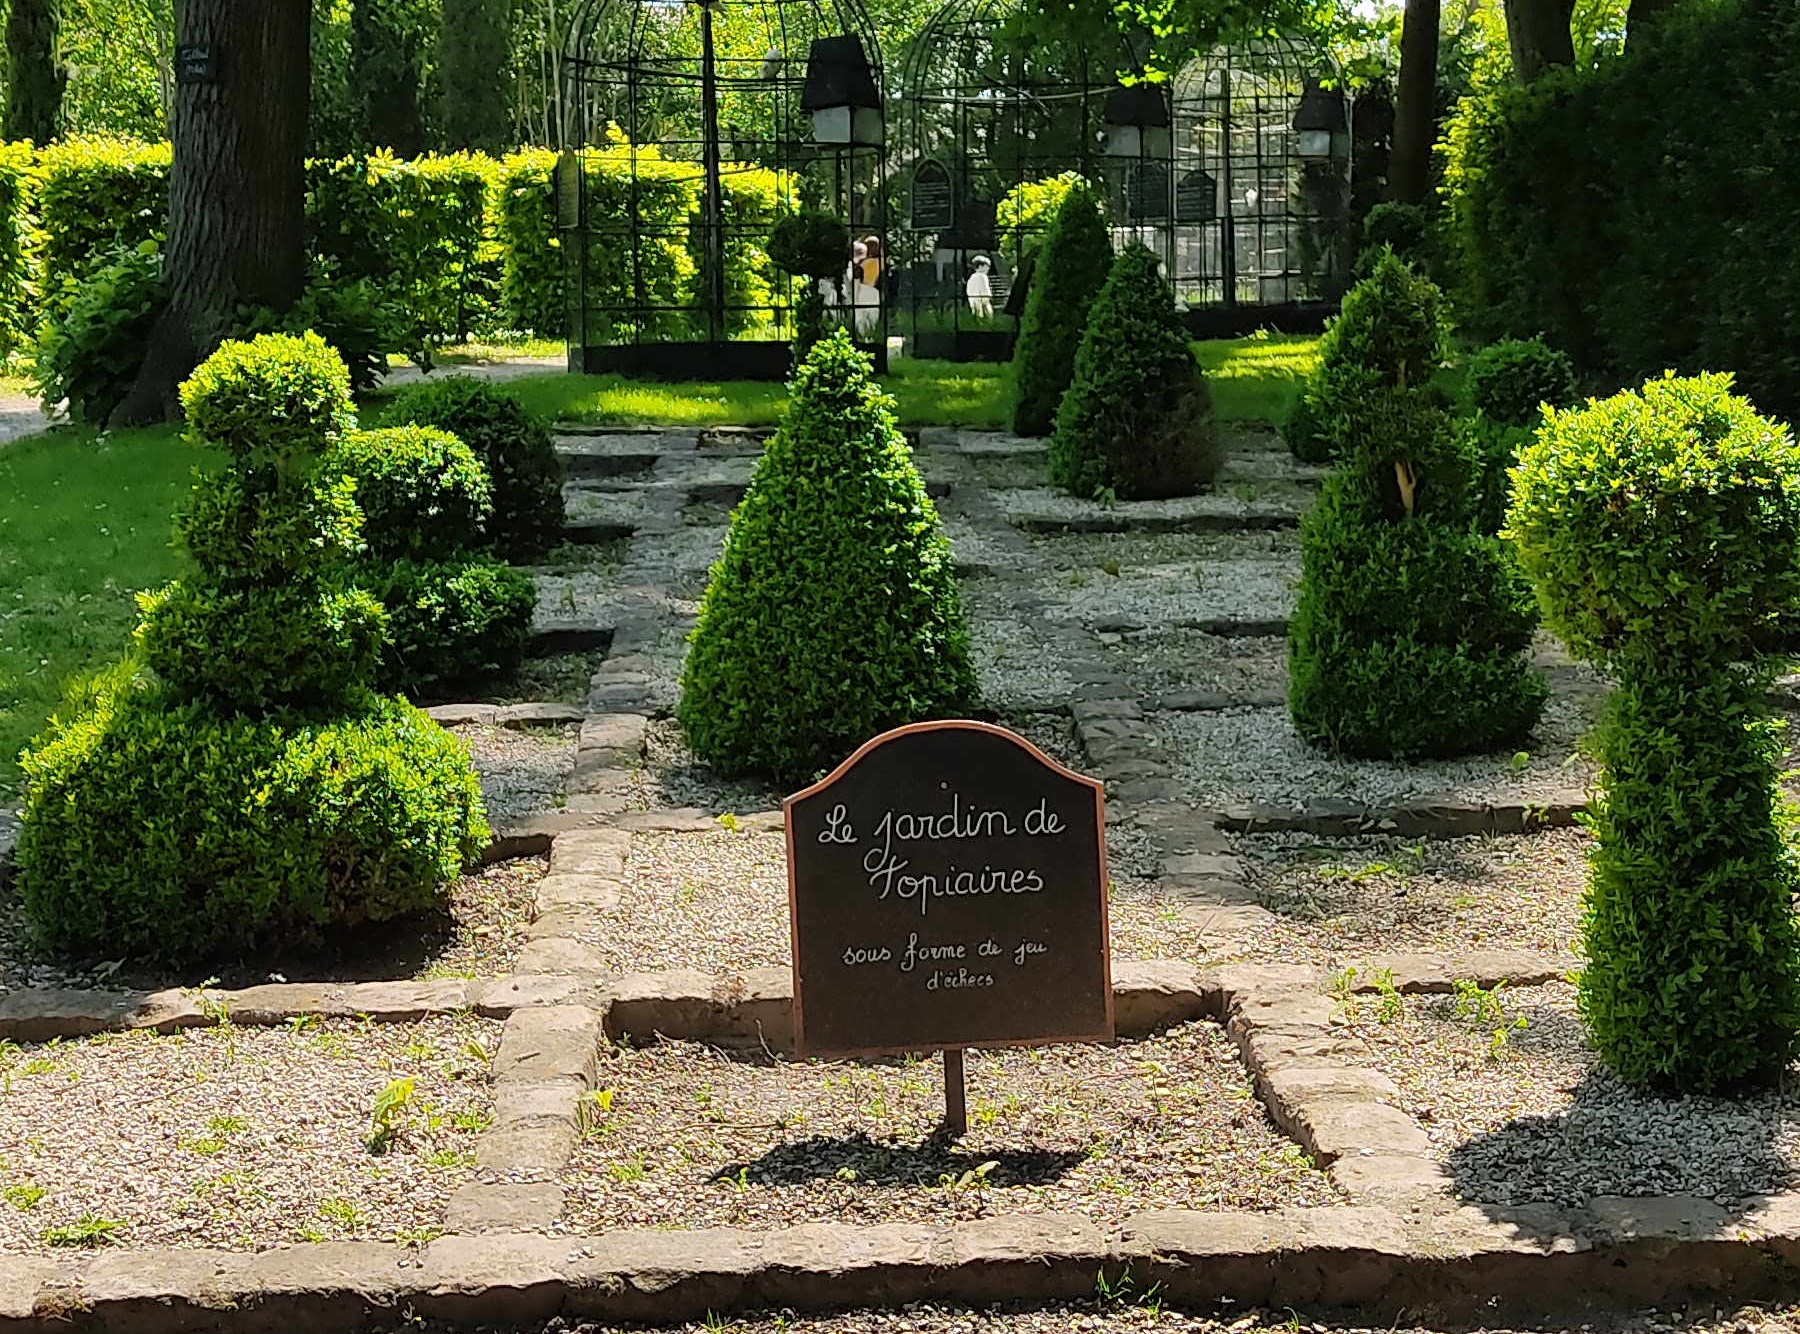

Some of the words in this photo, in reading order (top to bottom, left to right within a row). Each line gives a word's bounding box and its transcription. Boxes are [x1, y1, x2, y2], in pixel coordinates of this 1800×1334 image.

[818, 804, 857, 843] Le
[1024, 798, 1066, 835] de
[842, 945, 892, 965] sous
[901, 932, 966, 971] forme
[978, 939, 1002, 956] de
[1014, 938, 1048, 965] jeu
[926, 967, 994, 990] d'échecs
